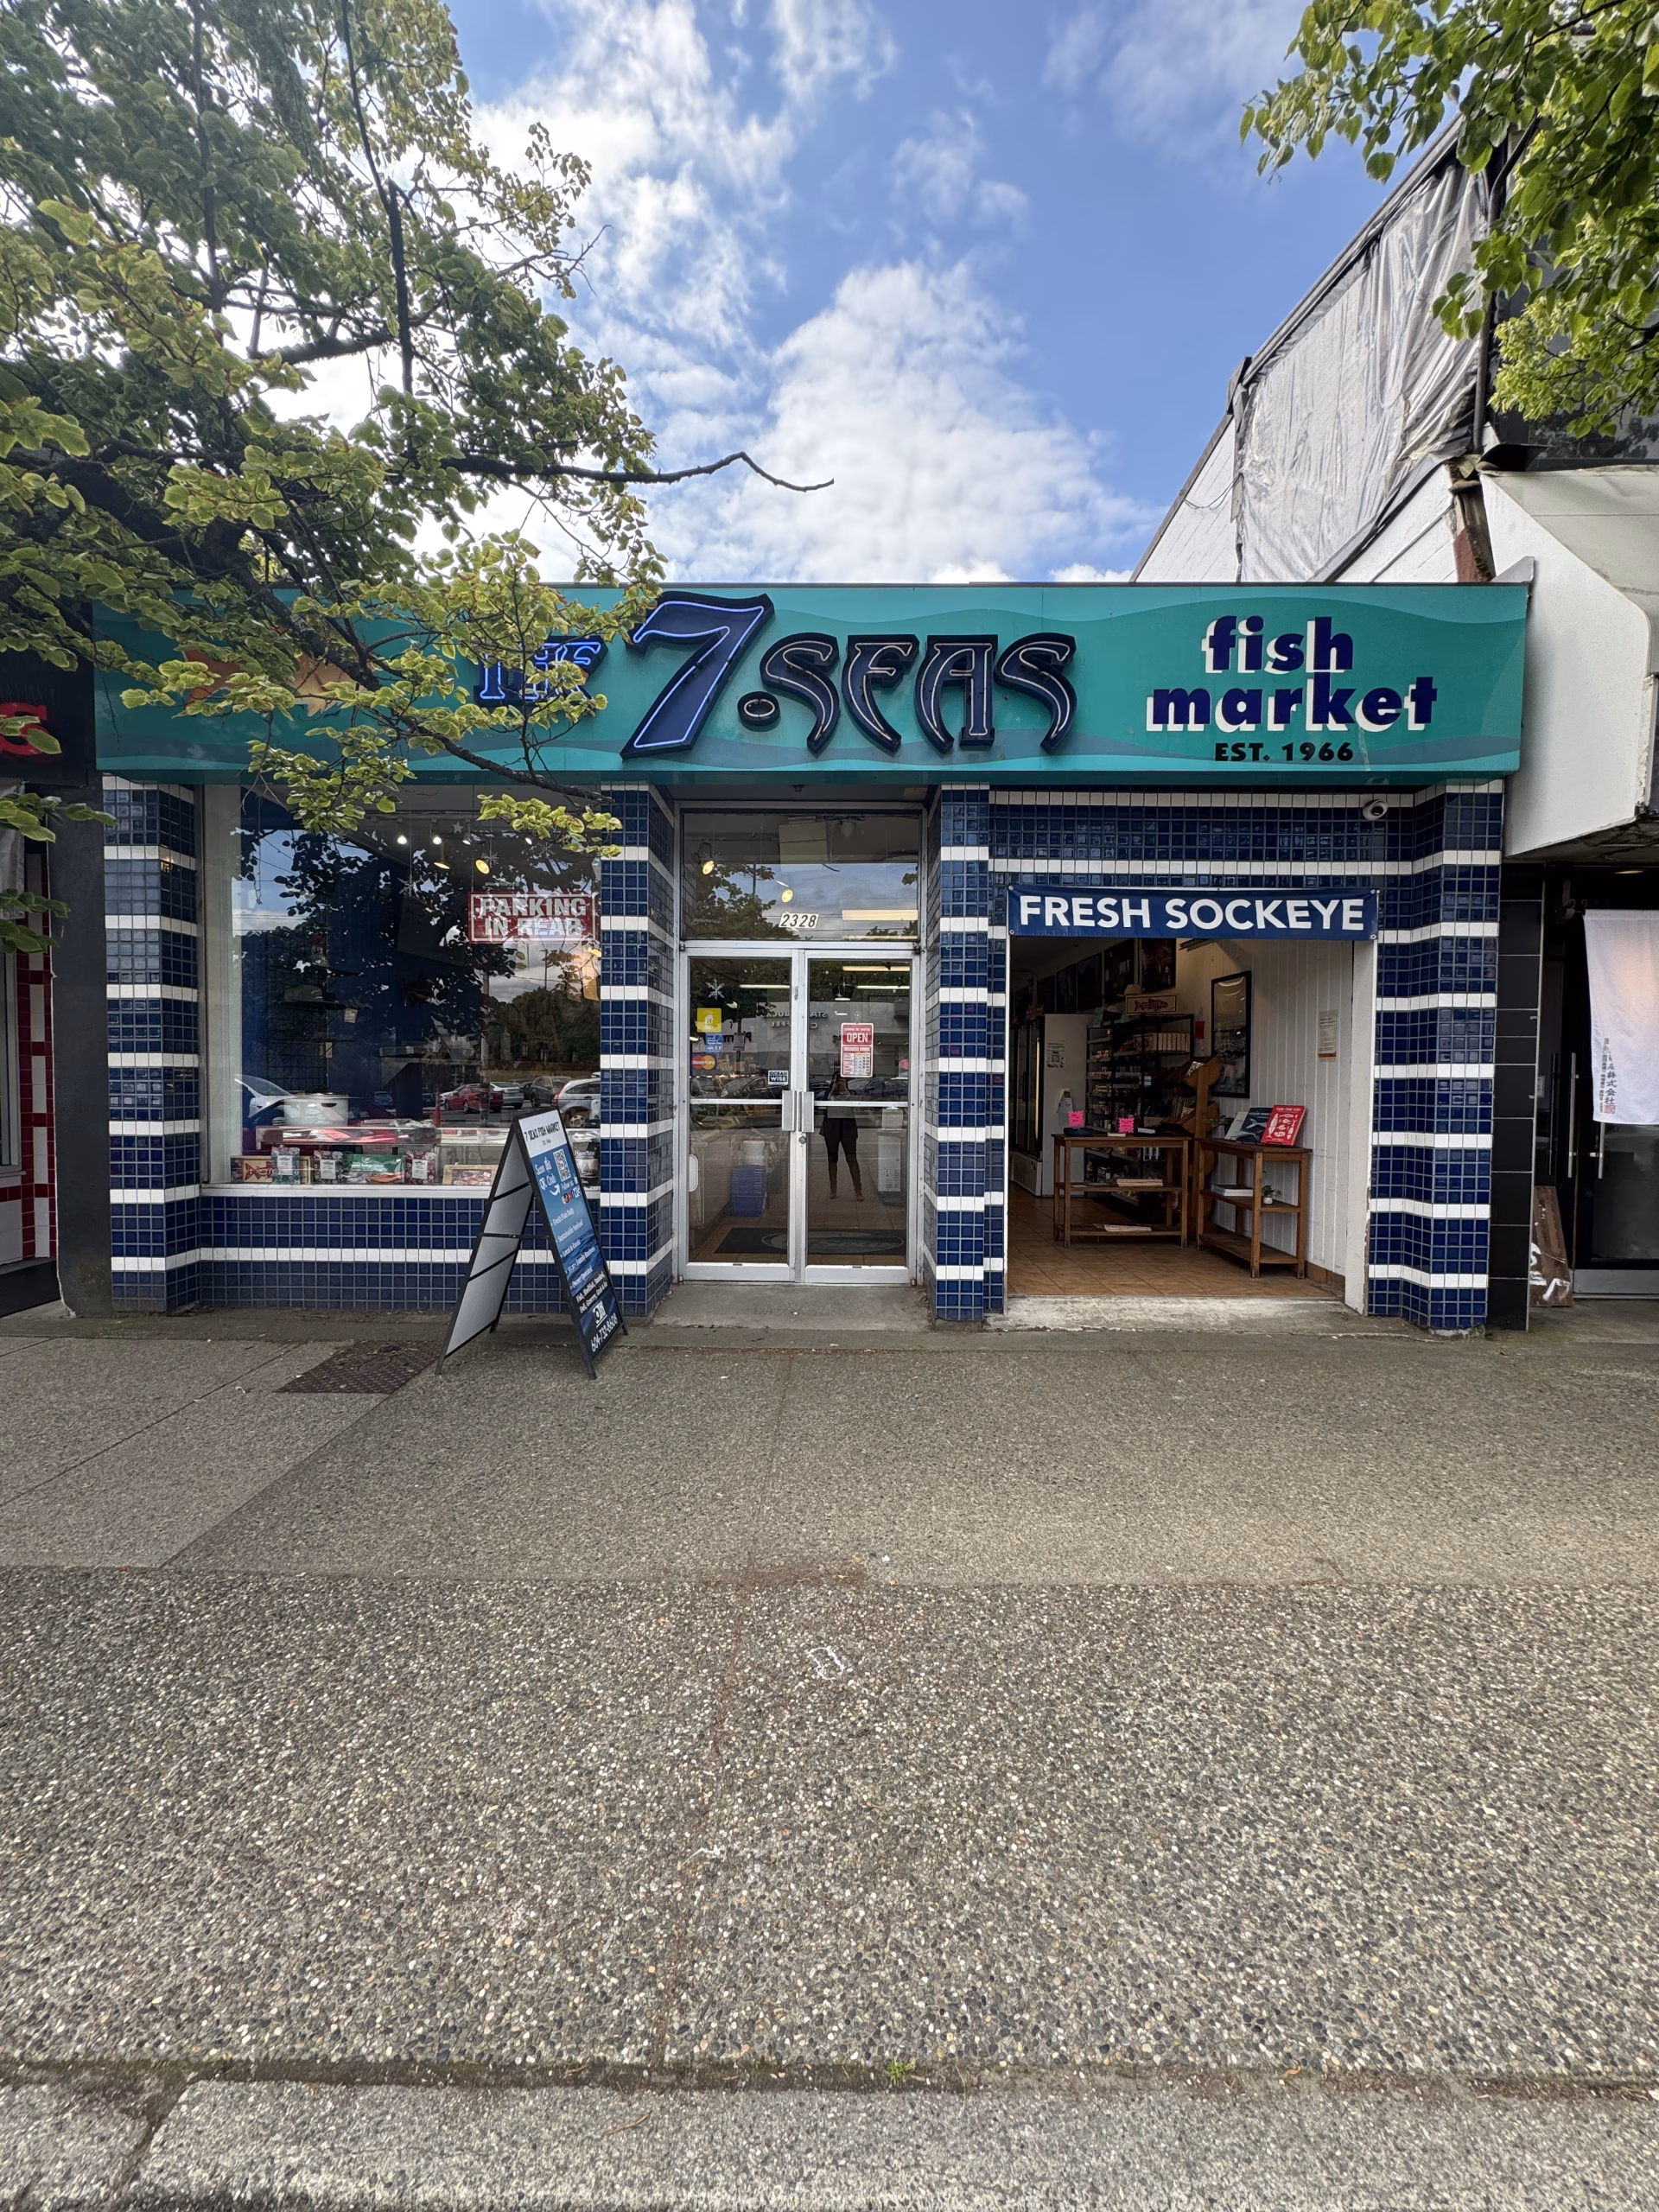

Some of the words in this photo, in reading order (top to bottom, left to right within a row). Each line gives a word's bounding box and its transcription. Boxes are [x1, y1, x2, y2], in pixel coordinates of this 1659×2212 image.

[1201, 615, 1355, 673] fish
[1146, 673, 1438, 733] market
[1215, 742, 1270, 763] EST.
[1282, 741, 1355, 763] 1966
[480, 898, 587, 917] PARKING
[1020, 894, 1150, 930] FRESH
[1166, 897, 1365, 932] SOCKEYE
[485, 918, 509, 936] IN
[518, 918, 582, 936] REAR
[780, 913, 817, 928] 2328
[847, 1033, 868, 1043] OPEN
[524, 1131, 528, 1141] 7
[528, 1128, 538, 1141] SEAS
[537, 1125, 547, 1137] FISH
[545, 1122, 560, 1135] MARKET
